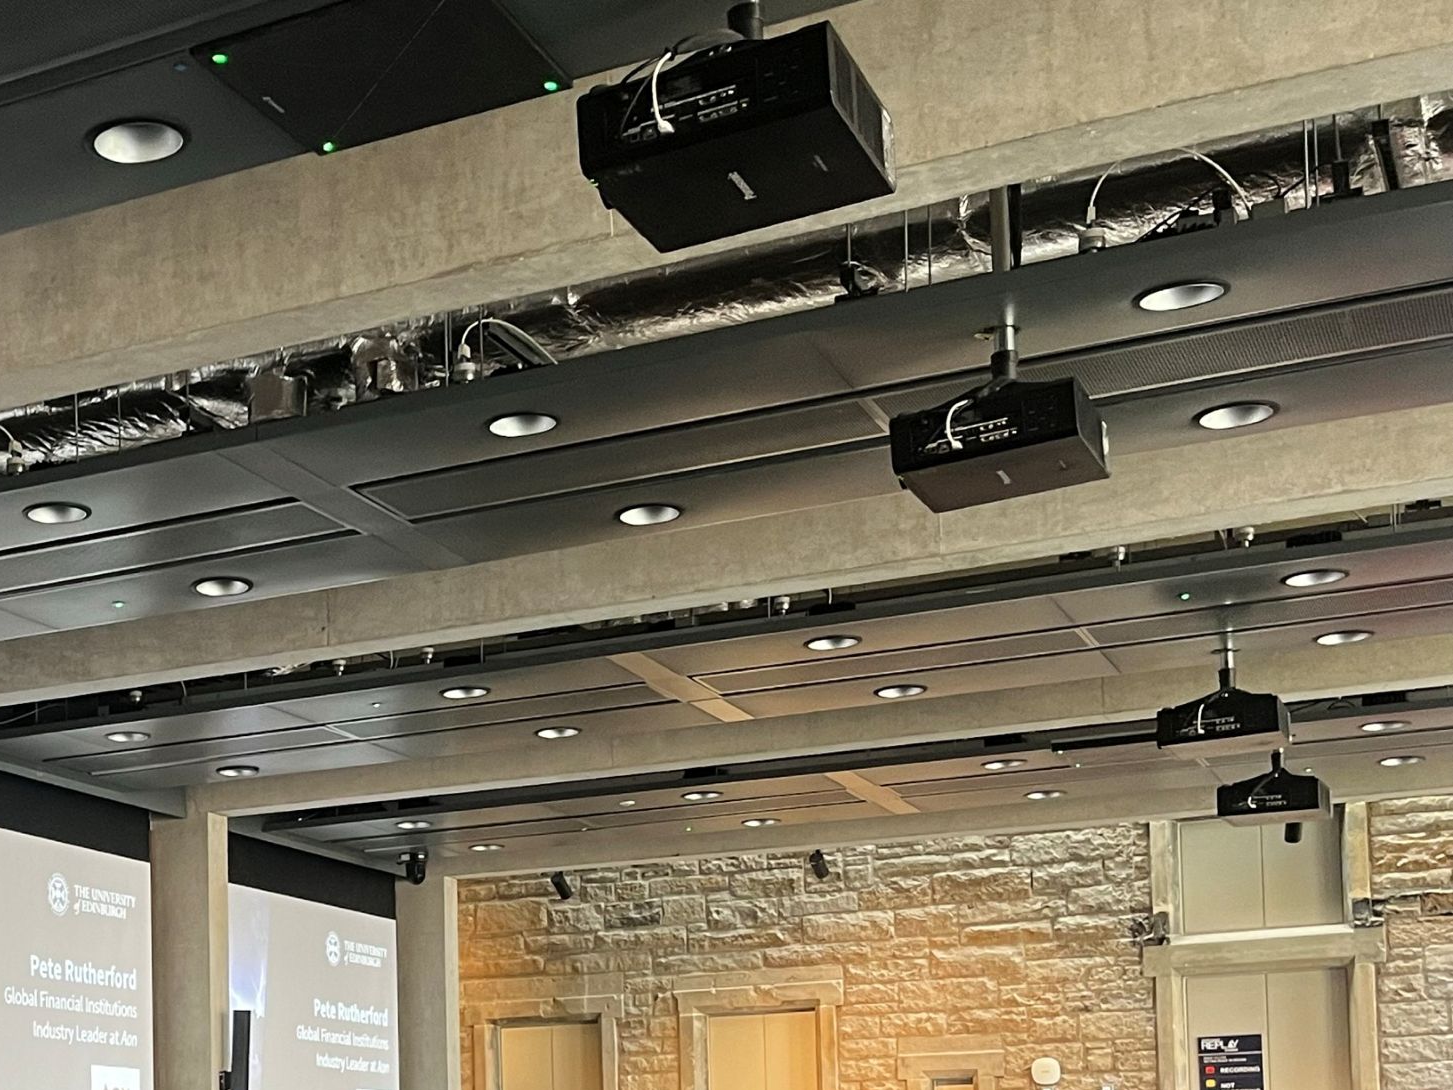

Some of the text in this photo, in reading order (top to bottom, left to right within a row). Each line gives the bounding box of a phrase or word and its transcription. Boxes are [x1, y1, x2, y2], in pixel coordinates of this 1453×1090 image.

[74, 884, 90, 899] THE
[91, 887, 136, 908] UNIVERSITY
[30, 954, 137, 990] Pete Rutherford
[4, 985, 138, 1018] Global Financial Institutions
[313, 998, 388, 1027] Pete Rutherford
[32, 1020, 138, 1047] Industry Leader at Aon
